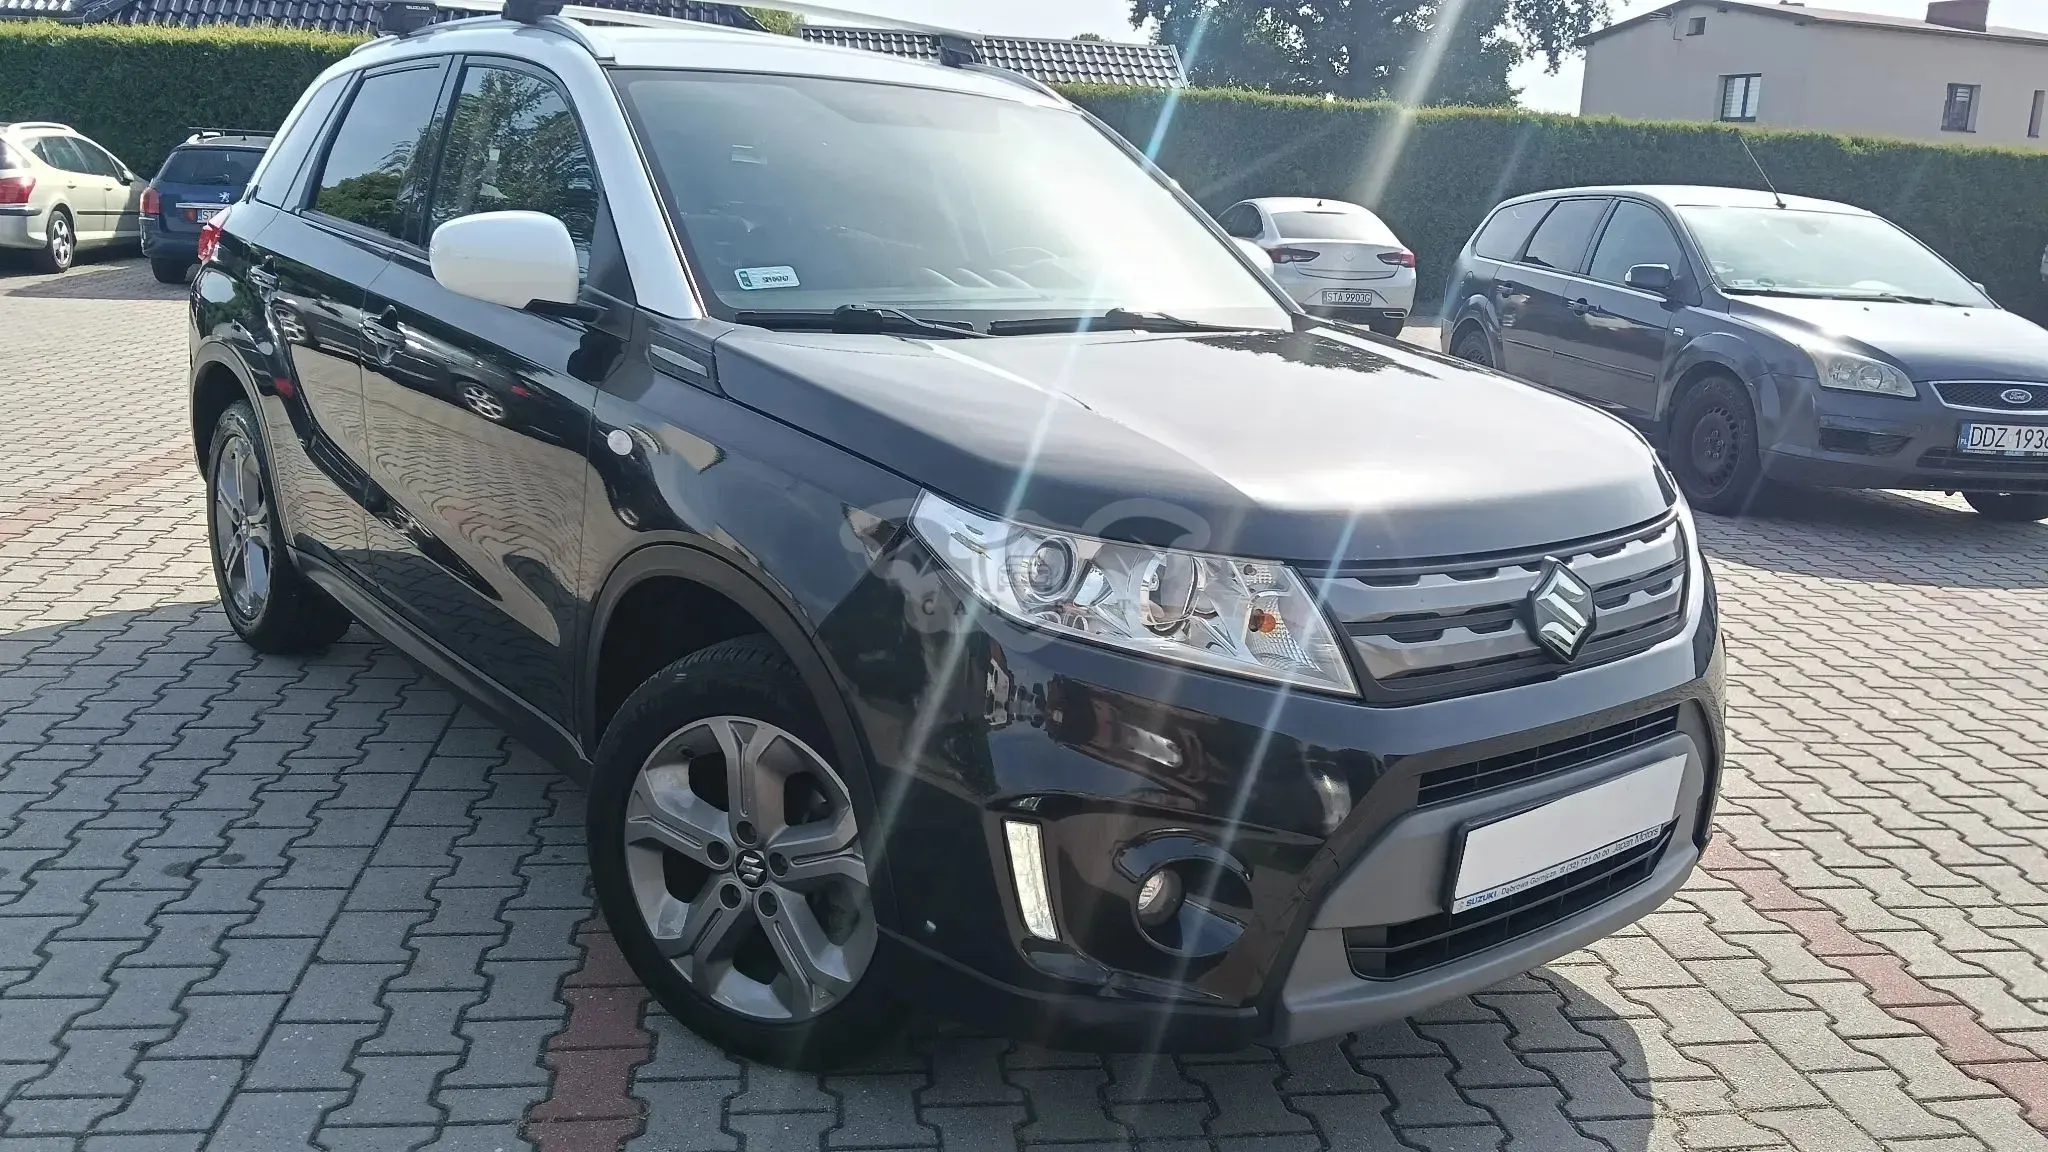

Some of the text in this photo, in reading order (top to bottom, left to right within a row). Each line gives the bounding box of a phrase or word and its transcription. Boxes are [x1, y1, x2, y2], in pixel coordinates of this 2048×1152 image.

[1327, 292, 1371, 303] STA 9903G
[1970, 426, 2008, 448] DDZ
[1466, 891, 1497, 906] SUZUKI
[1612, 839, 1634, 853] Japan
[1634, 828, 1659, 844] Motors
